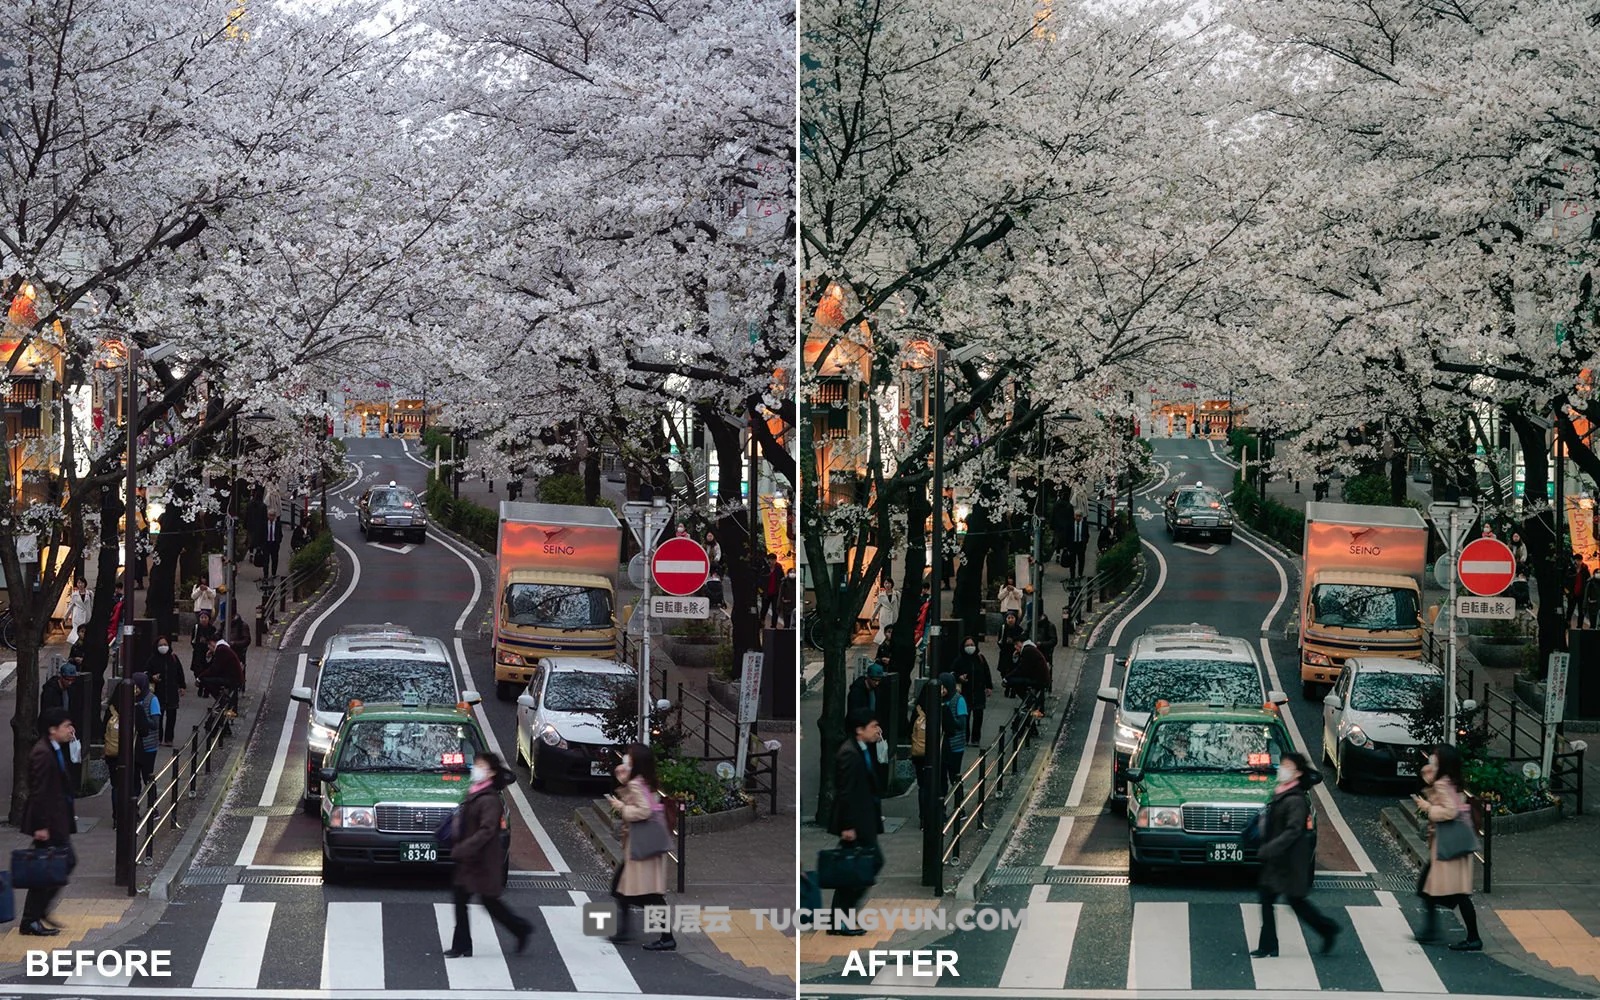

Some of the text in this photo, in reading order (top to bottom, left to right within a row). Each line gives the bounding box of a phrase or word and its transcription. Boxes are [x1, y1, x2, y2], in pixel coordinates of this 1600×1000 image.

[543, 544, 575, 556] SEINO
[1349, 545, 1381, 556] SEINO
[655, 601, 705, 615] 自転車を除く
[1461, 601, 1511, 615] 自転車を除く
[408, 850, 437, 861] 83-40
[1214, 850, 1243, 861] 83-40
